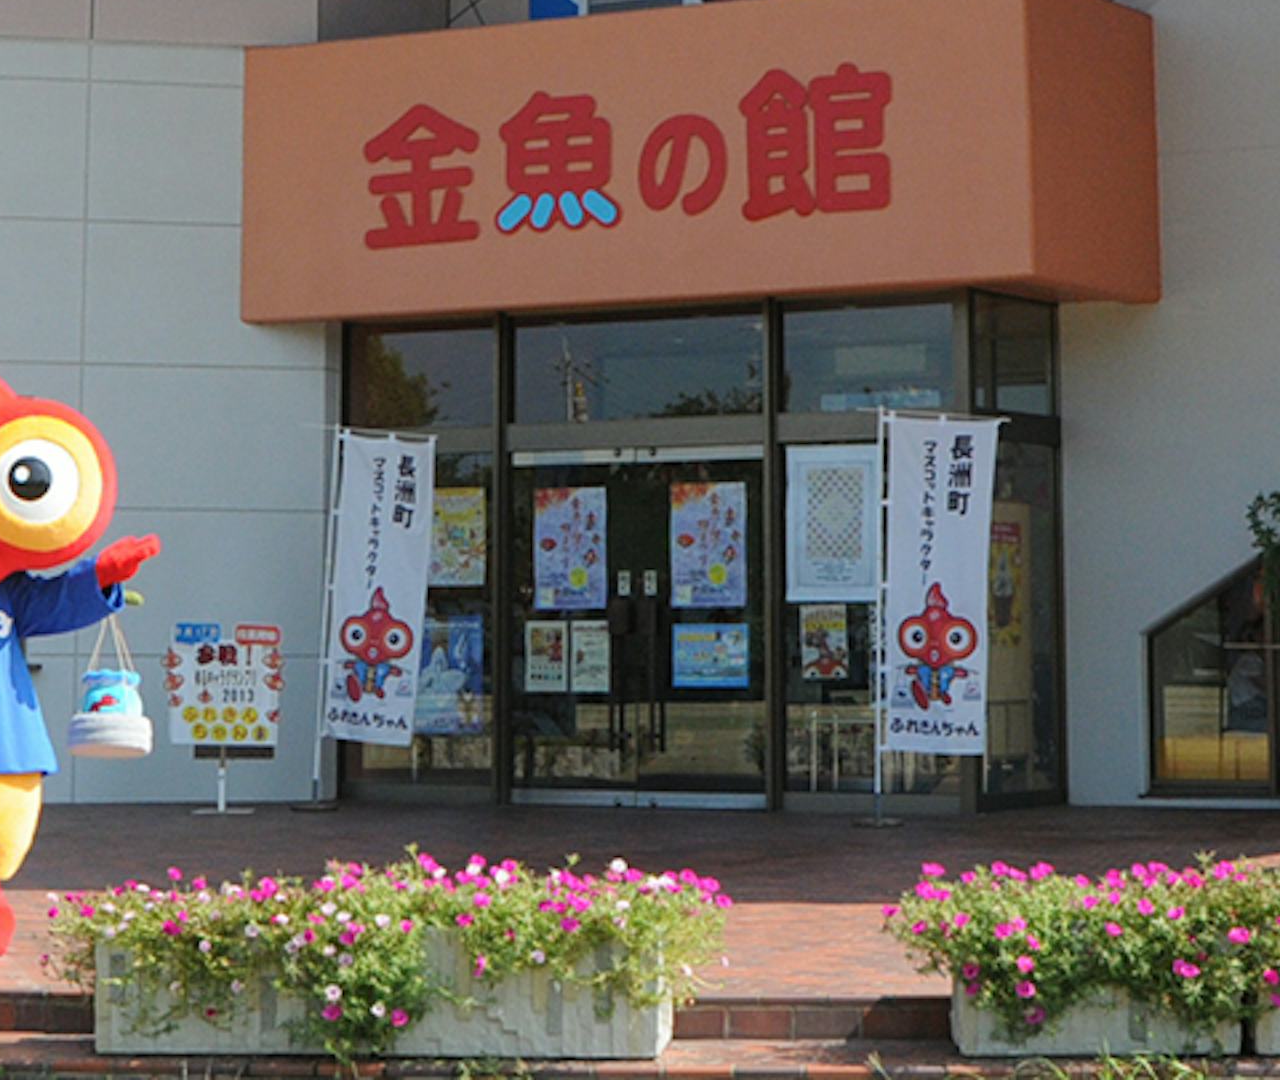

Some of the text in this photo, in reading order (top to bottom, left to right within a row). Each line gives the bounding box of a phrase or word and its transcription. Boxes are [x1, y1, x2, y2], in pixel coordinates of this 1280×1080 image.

[364, 62, 893, 250] 金魚の館
[393, 454, 417, 529] 長洲町
[919, 439, 937, 586] マスコットキャラクター
[947, 434, 974, 516] 長洲町
[365, 456, 386, 590] マスコットキャラクター
[222, 688, 254, 703] 2013
[890, 717, 979, 736] ふれきんちゃん
